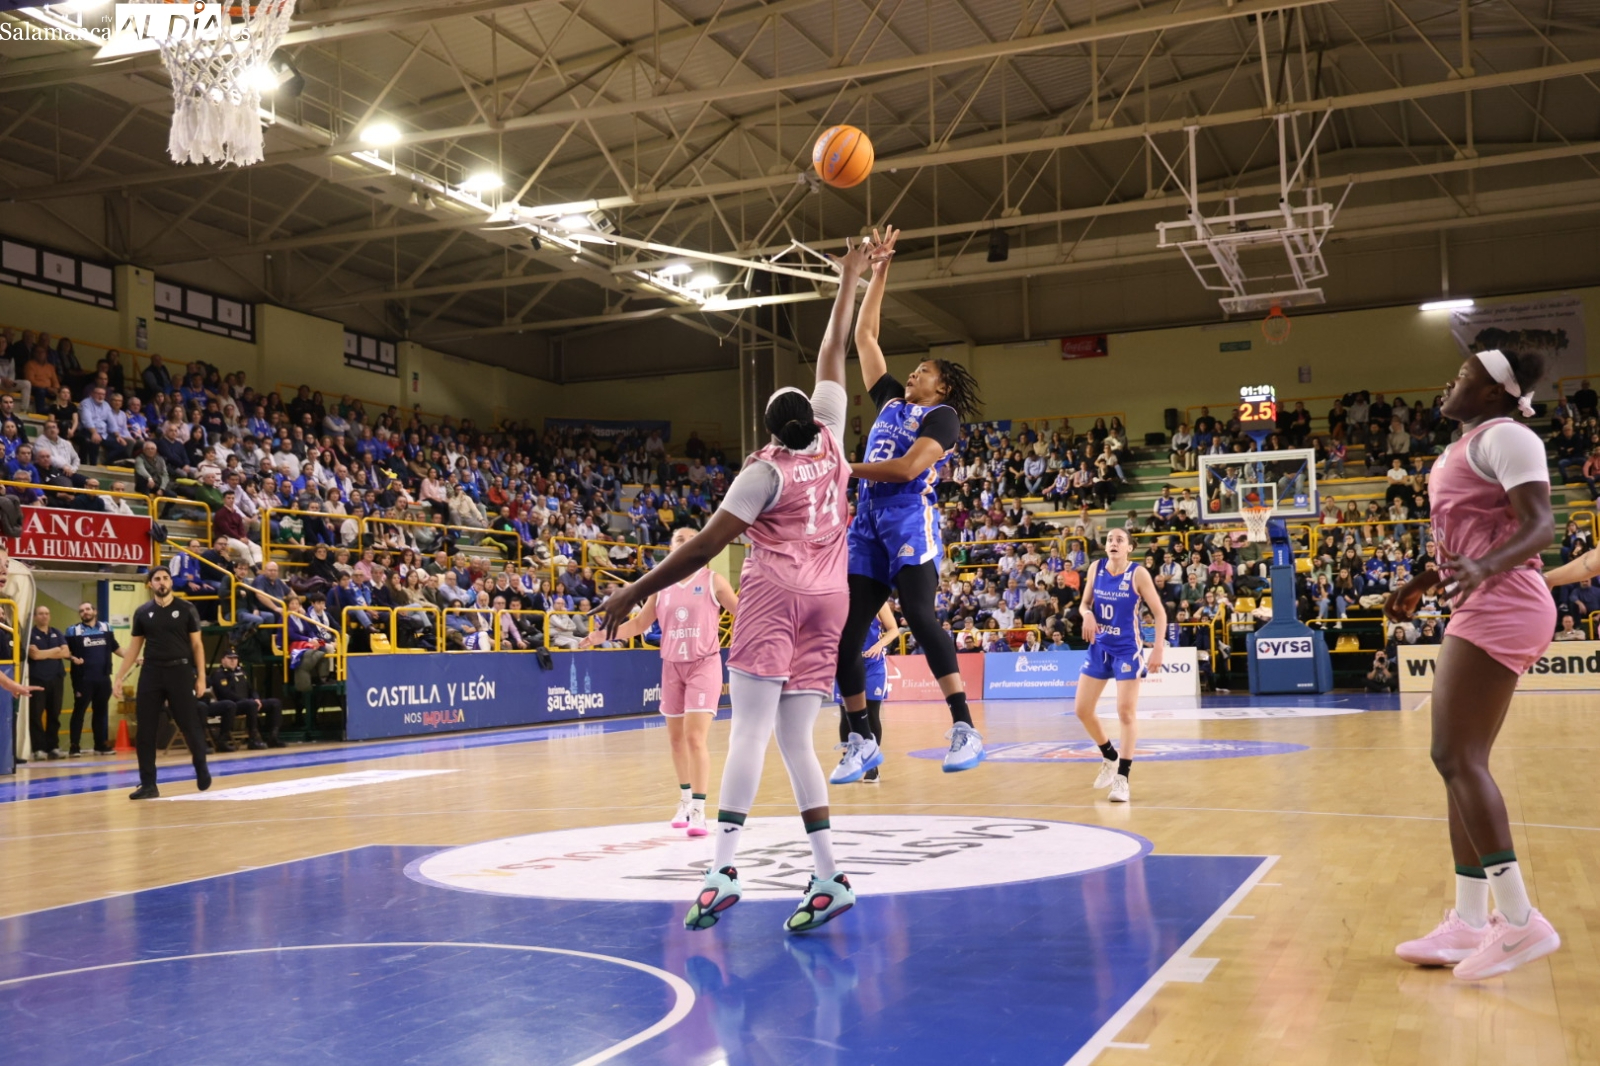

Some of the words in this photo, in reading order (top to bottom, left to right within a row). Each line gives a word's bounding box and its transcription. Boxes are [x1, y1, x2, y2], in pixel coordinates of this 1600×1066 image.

[1240, 401, 1272, 421] 2.5
[806, 479, 840, 535] 14
[24, 512, 118, 539] ANCA
[14, 537, 38, 556] LA
[42, 538, 144, 561] HUMANIDAD
[1100, 603, 1114, 620] 10
[1097, 623, 1120, 636] yrsa
[678, 641, 689, 660] 4
[366, 683, 441, 708] CASTILLA
[446, 682, 457, 707] Y
[461, 674, 496, 701] LEÓN
[547, 684, 566, 696] turismo
[403, 711, 422, 724] NOS
[422, 708, 465, 729] IMPULSA
